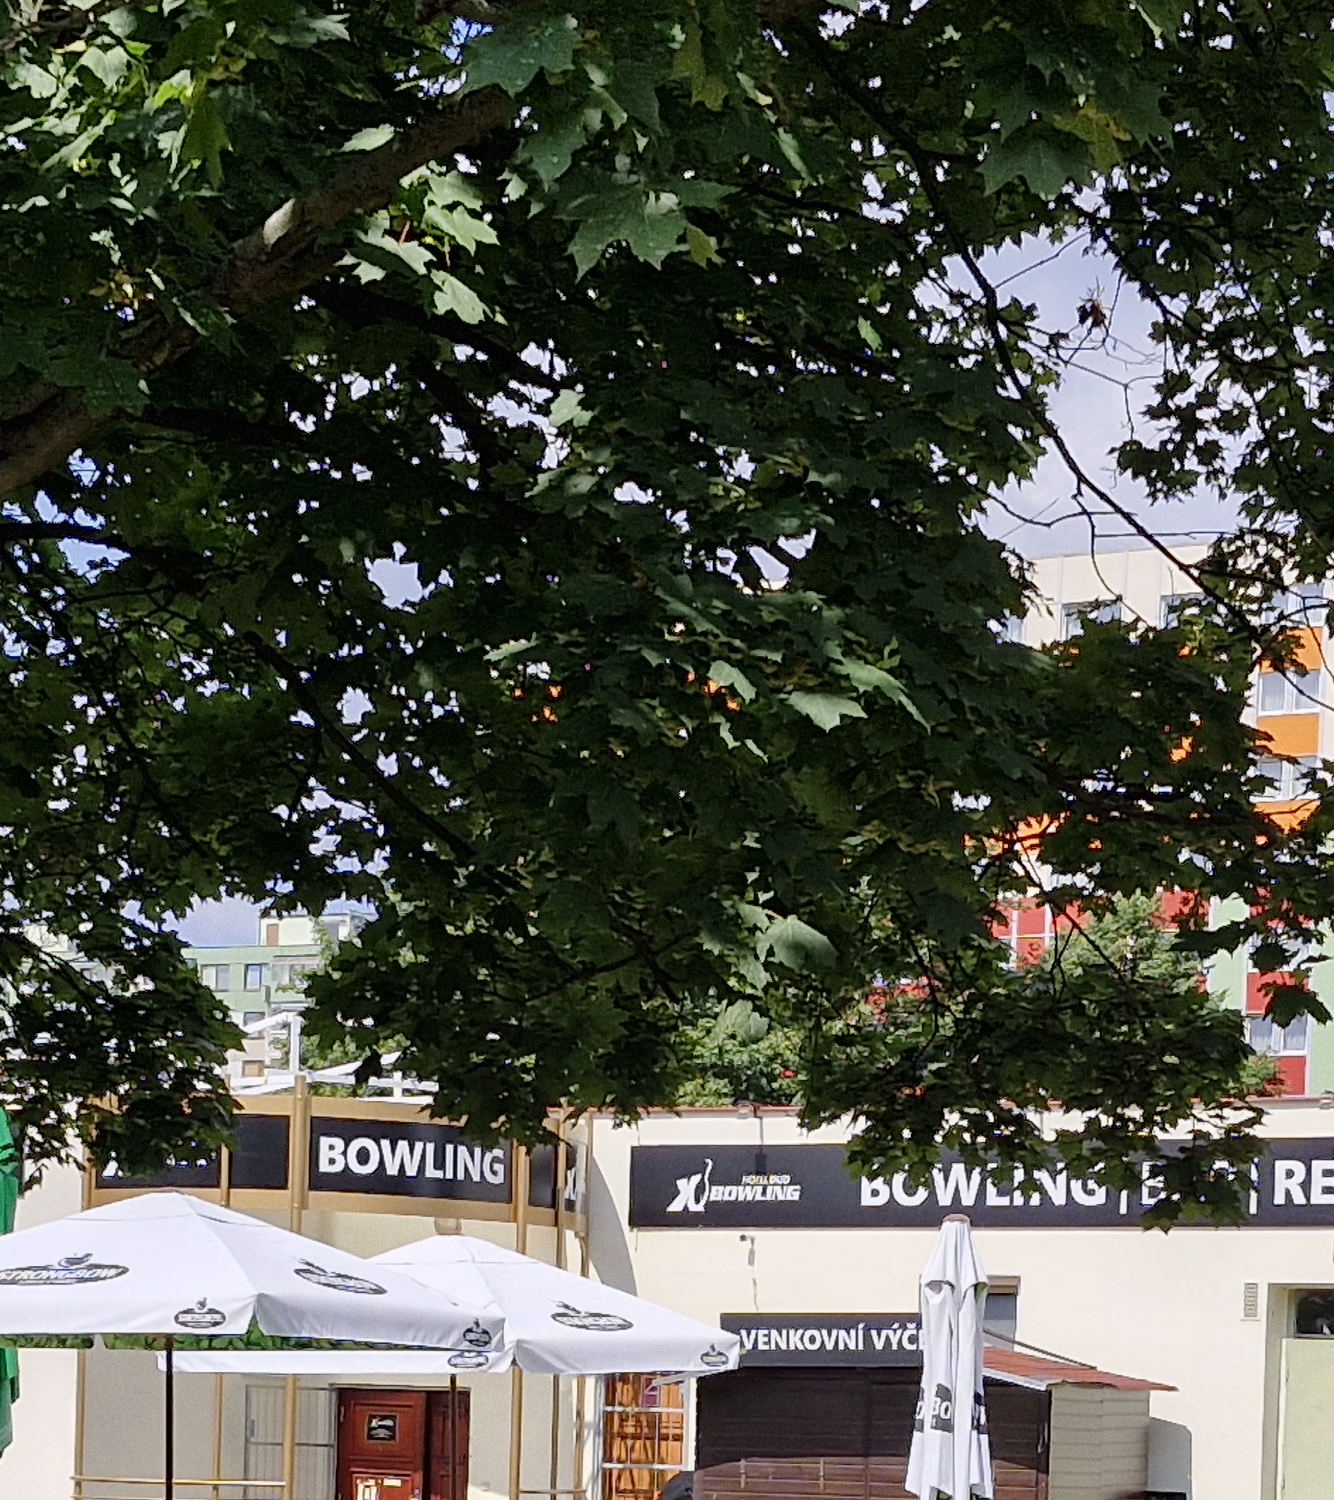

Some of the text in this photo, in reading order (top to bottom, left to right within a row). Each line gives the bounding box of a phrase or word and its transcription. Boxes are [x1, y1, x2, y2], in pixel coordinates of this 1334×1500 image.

[318, 1136, 506, 1184] BOWLING
[710, 1185, 802, 1202] BOWLING
[740, 1322, 865, 1351] VENKOVNÍ
